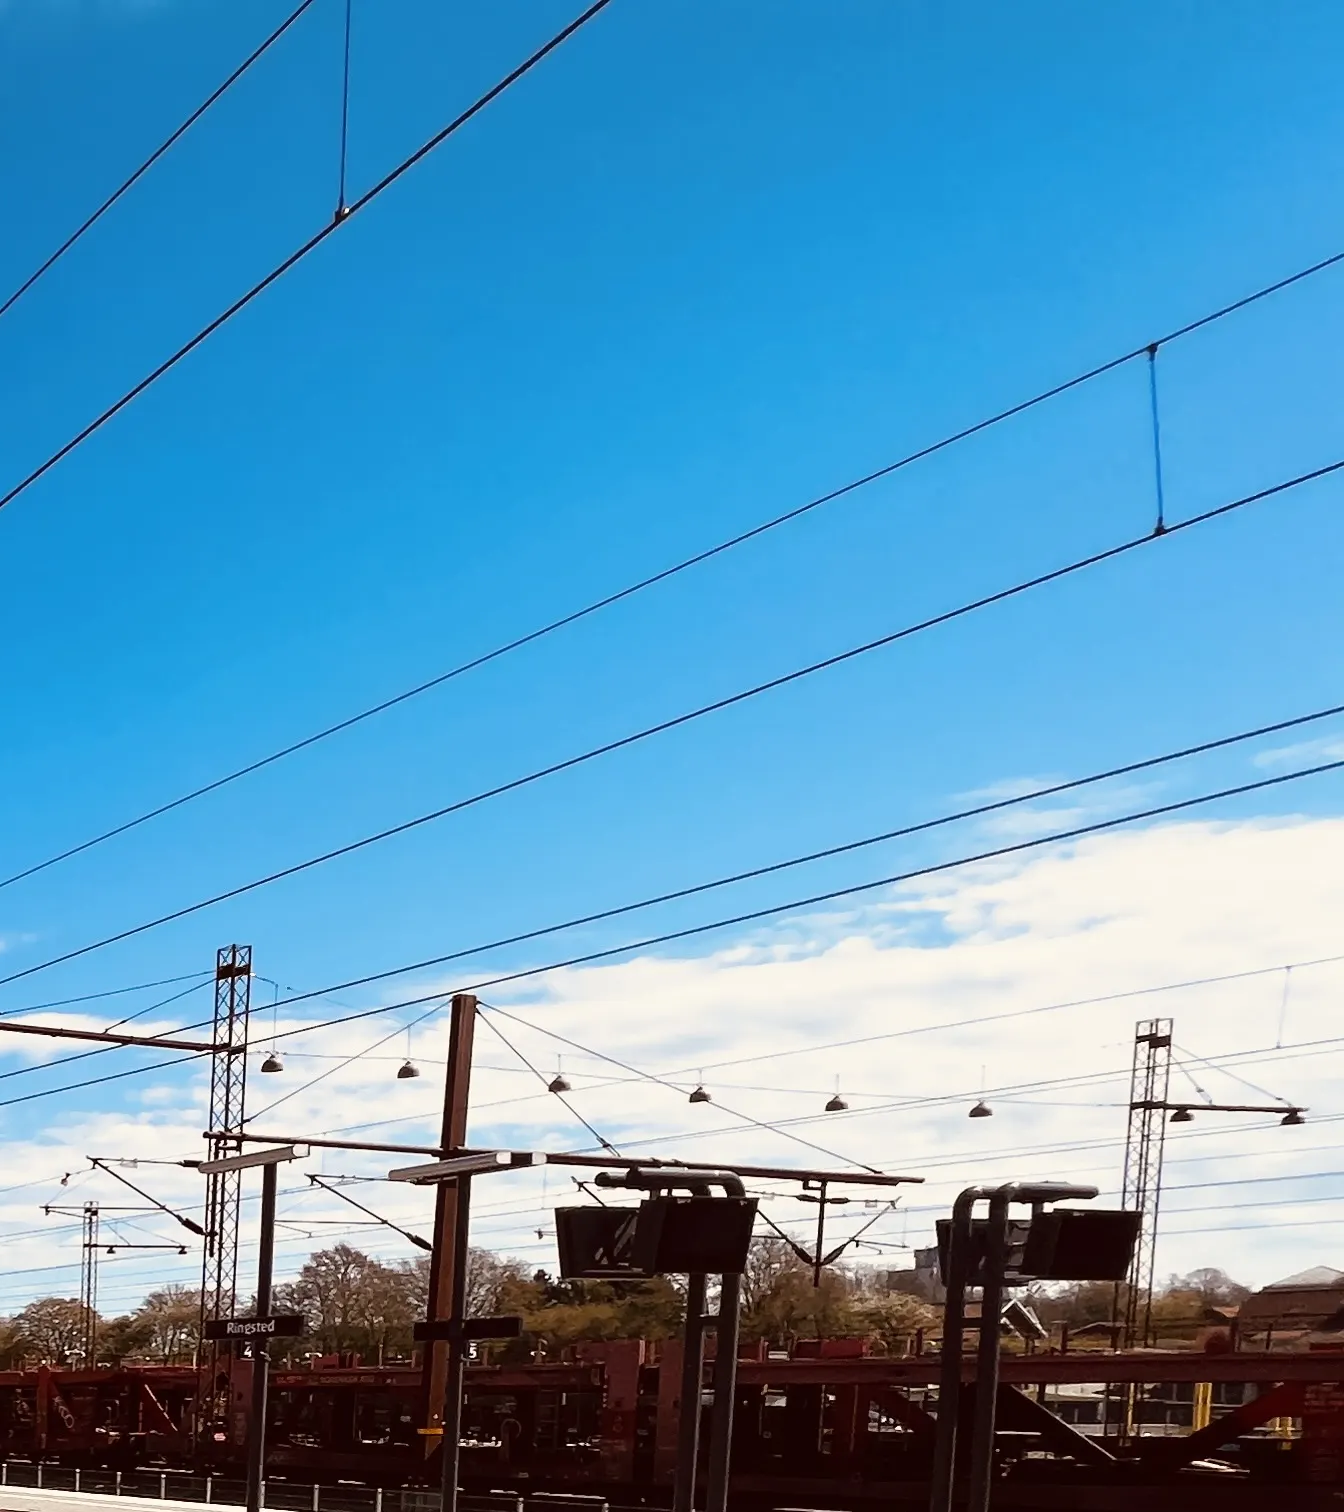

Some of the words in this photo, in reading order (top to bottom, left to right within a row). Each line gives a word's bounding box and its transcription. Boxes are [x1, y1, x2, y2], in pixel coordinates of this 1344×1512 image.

[226, 1319, 275, 1335] Ringsted
[243, 1345, 253, 1358] 4
[468, 1346, 478, 1359] 5
